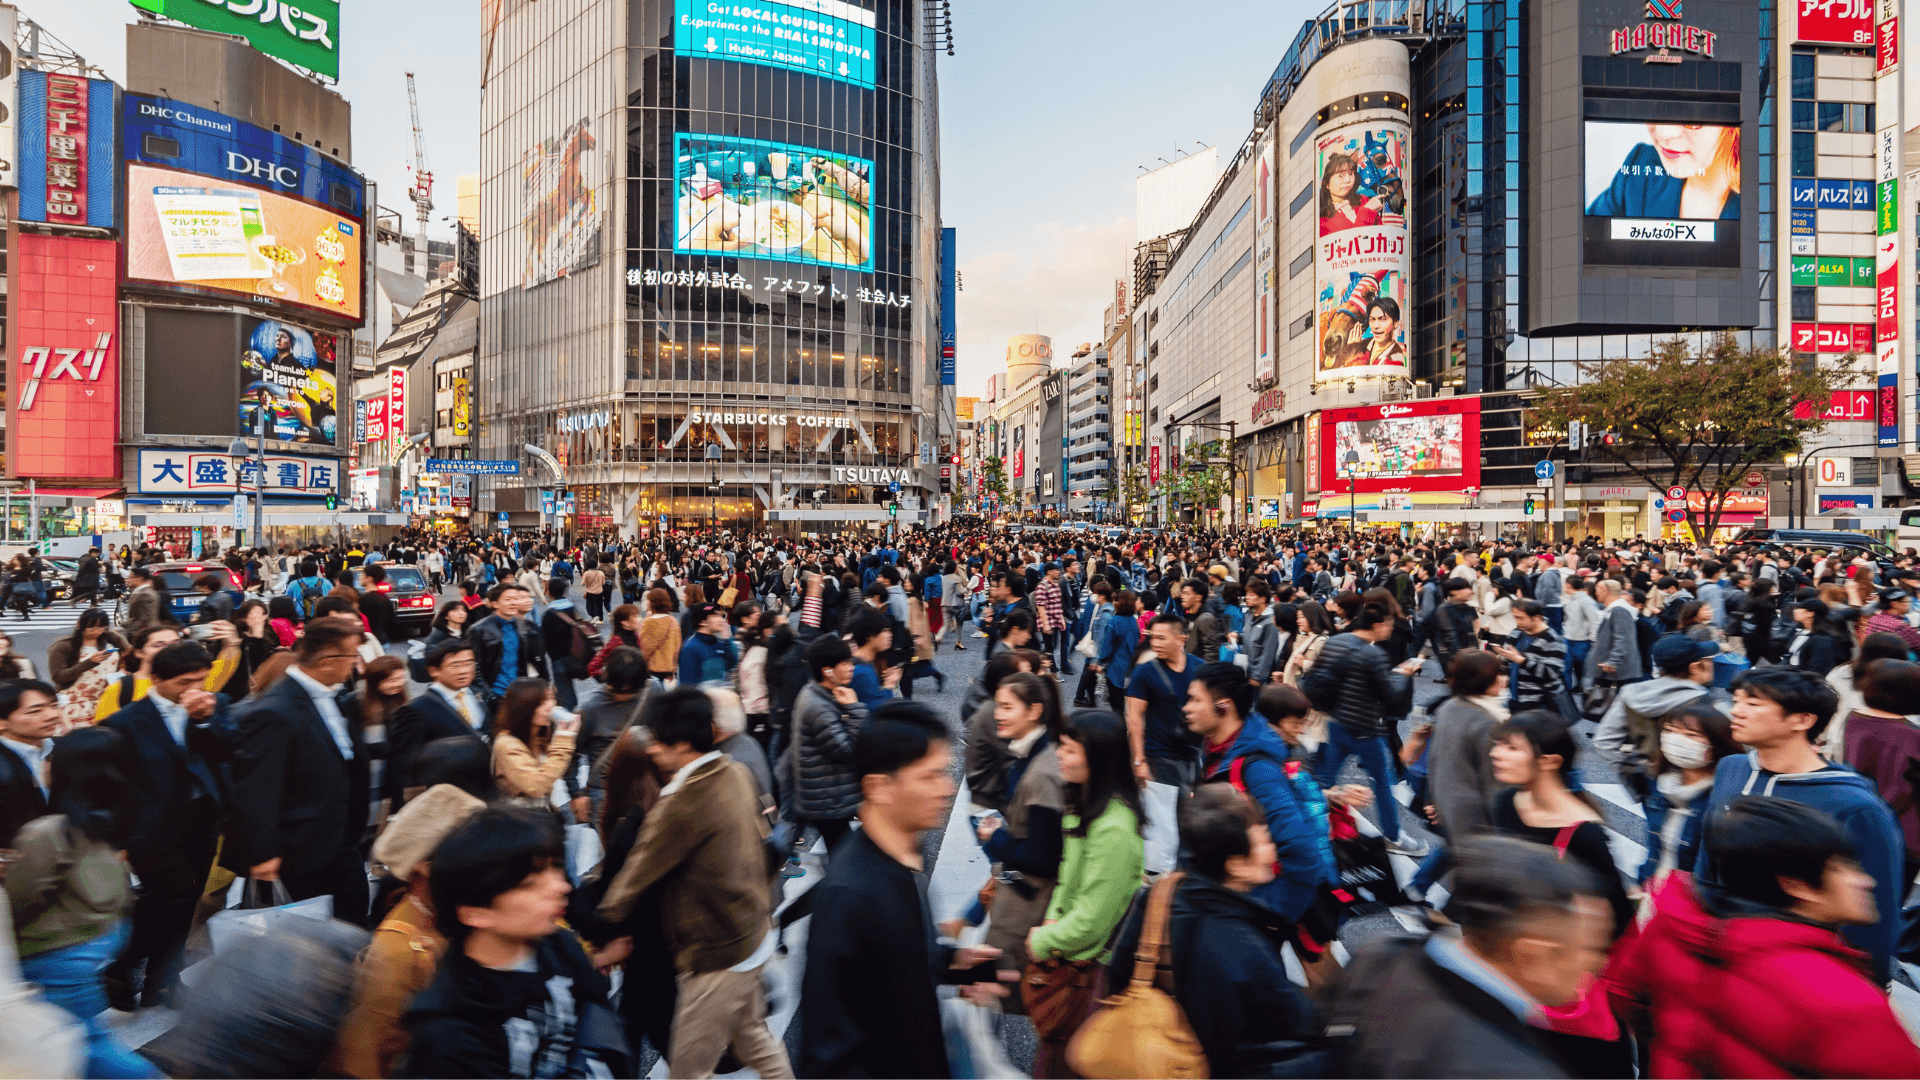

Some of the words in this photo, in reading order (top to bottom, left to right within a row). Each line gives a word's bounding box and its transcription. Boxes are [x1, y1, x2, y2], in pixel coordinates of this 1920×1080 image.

[1800, 0, 1872, 19] アイフル
[708, 3, 730, 15] Get
[733, 6, 779, 23] LOCAL
[780, 14, 833, 35] GUIDES
[836, 28, 845, 38] &
[681, 15, 748, 32] Experience
[752, 24, 770, 36] the
[774, 28, 809, 44] REAL
[811, 35, 870, 60] SHIBUYA
[1611, 23, 1717, 58] MAGNET
[1853, 30, 1871, 42] 8F
[772, 49, 807, 65] Japan
[1882, 31, 1894, 68] アイフル
[140, 104, 173, 119] DHC
[175, 111, 232, 133] Channel
[47, 77, 80, 216] 三千里薬品
[226, 151, 297, 188] DHC
[1630, 225, 1697, 239] みんなのFX
[1324, 233, 1404, 261] ジャパンカップ
[1792, 263, 1815, 273] レイク
[1818, 264, 1844, 273] ALSA
[1858, 267, 1872, 277] 5F
[627, 269, 753, 289] 後初の対外試合。
[763, 276, 849, 299] アメフット。
[856, 286, 912, 308] 社会人チ
[253, 295, 274, 305] DHC
[1881, 286, 1895, 318] アコム
[1798, 330, 1849, 346] アコム
[943, 333, 954, 374] SEIBU
[18, 332, 112, 411] クスリ
[263, 369, 319, 390] Planets
[271, 362, 305, 376] teamLab
[280, 387, 305, 395] TOKYO
[392, 375, 403, 422] カラオケ
[277, 398, 307, 409] TOYOSU
[1252, 390, 1286, 424] MAGNET
[1380, 405, 1412, 418] Glico
[1825, 406, 1843, 416] 入口
[1882, 386, 1894, 427] PROMISE
[273, 425, 310, 436] DMM.com
[692, 412, 788, 426] STARBUCKS
[797, 415, 851, 429] COFFEE
[152, 458, 331, 488] 大盛堂書店
[835, 467, 911, 484] TSUTAYA
[1822, 459, 1844, 482] 0円
[1823, 500, 1855, 508] PROMISE
